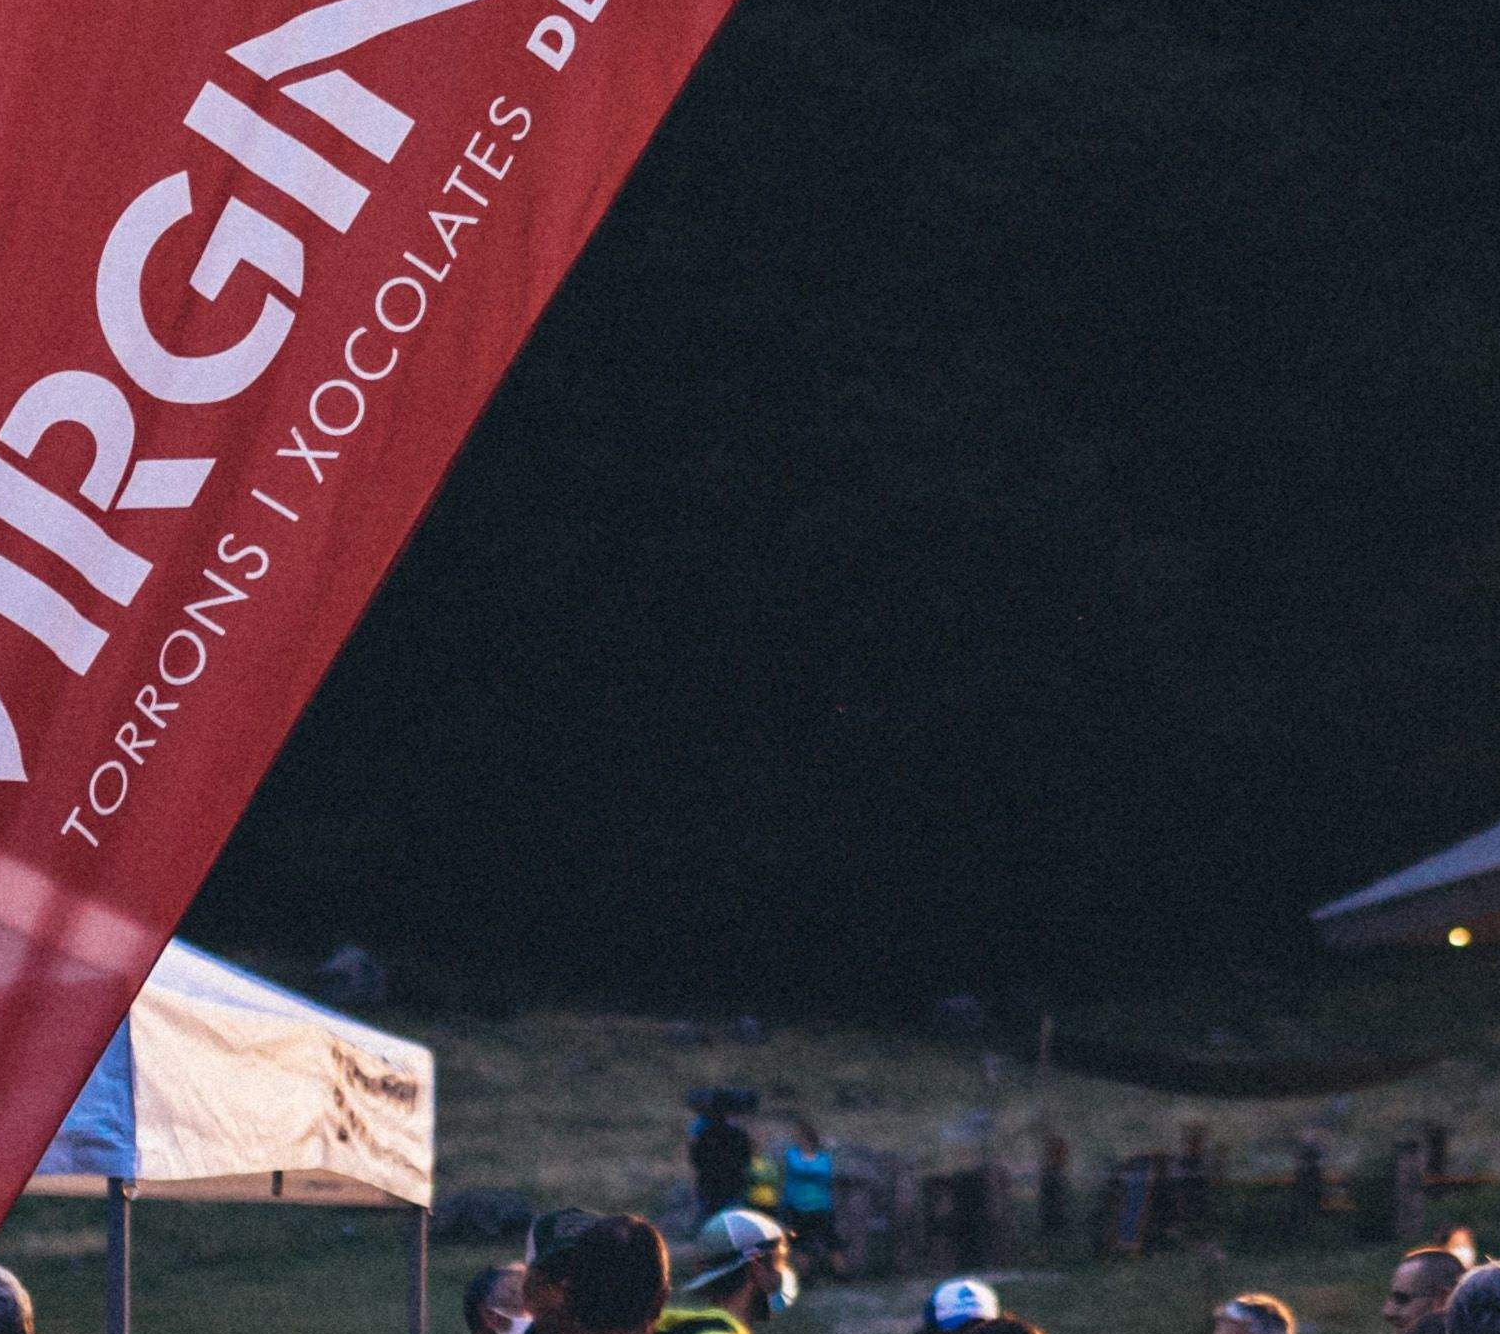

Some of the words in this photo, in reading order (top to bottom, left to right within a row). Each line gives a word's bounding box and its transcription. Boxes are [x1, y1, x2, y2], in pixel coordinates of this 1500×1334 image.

[61, 533, 270, 848] TORRONS
[251, 488, 299, 522] I
[276, 95, 532, 485] XOCOLATES
